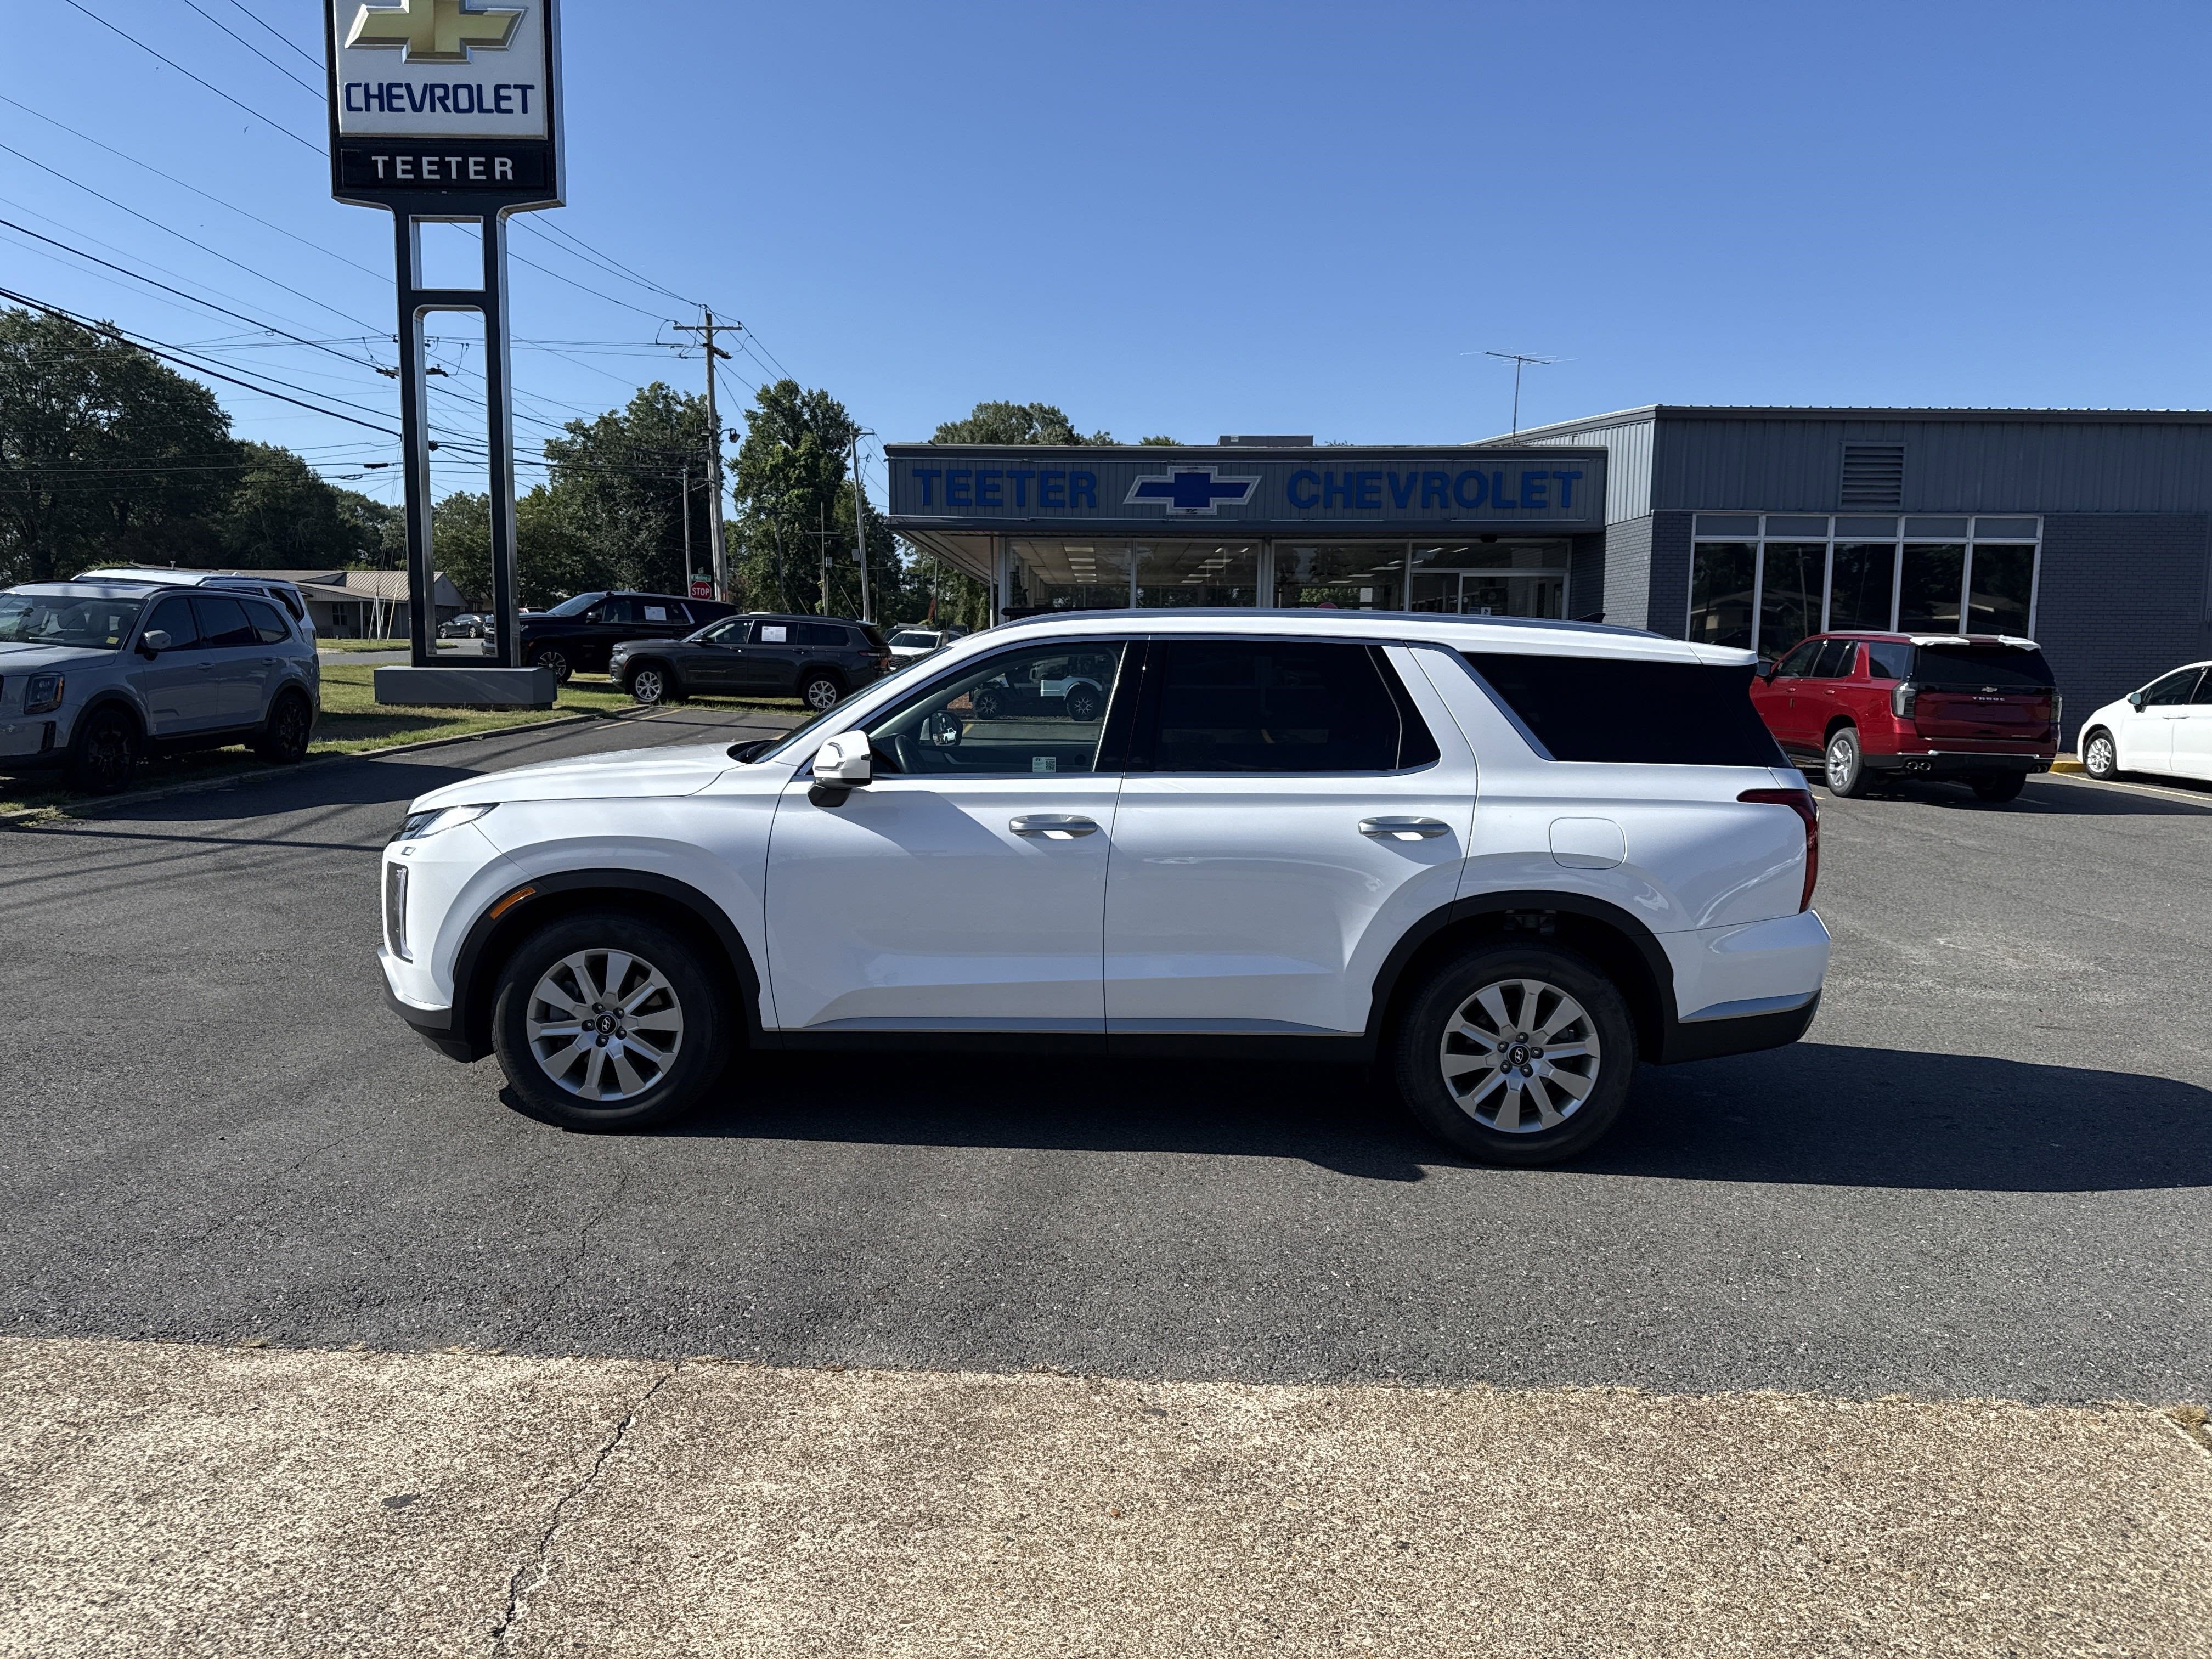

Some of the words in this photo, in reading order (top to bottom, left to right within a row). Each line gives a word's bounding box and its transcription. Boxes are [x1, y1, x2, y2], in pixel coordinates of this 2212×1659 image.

[345, 82, 535, 114] CHEVROLET
[372, 156, 513, 180] TEETER
[912, 469, 1097, 509] TEETER
[1287, 470, 1582, 509] CHEVROLET
[692, 587, 709, 595] STOP
